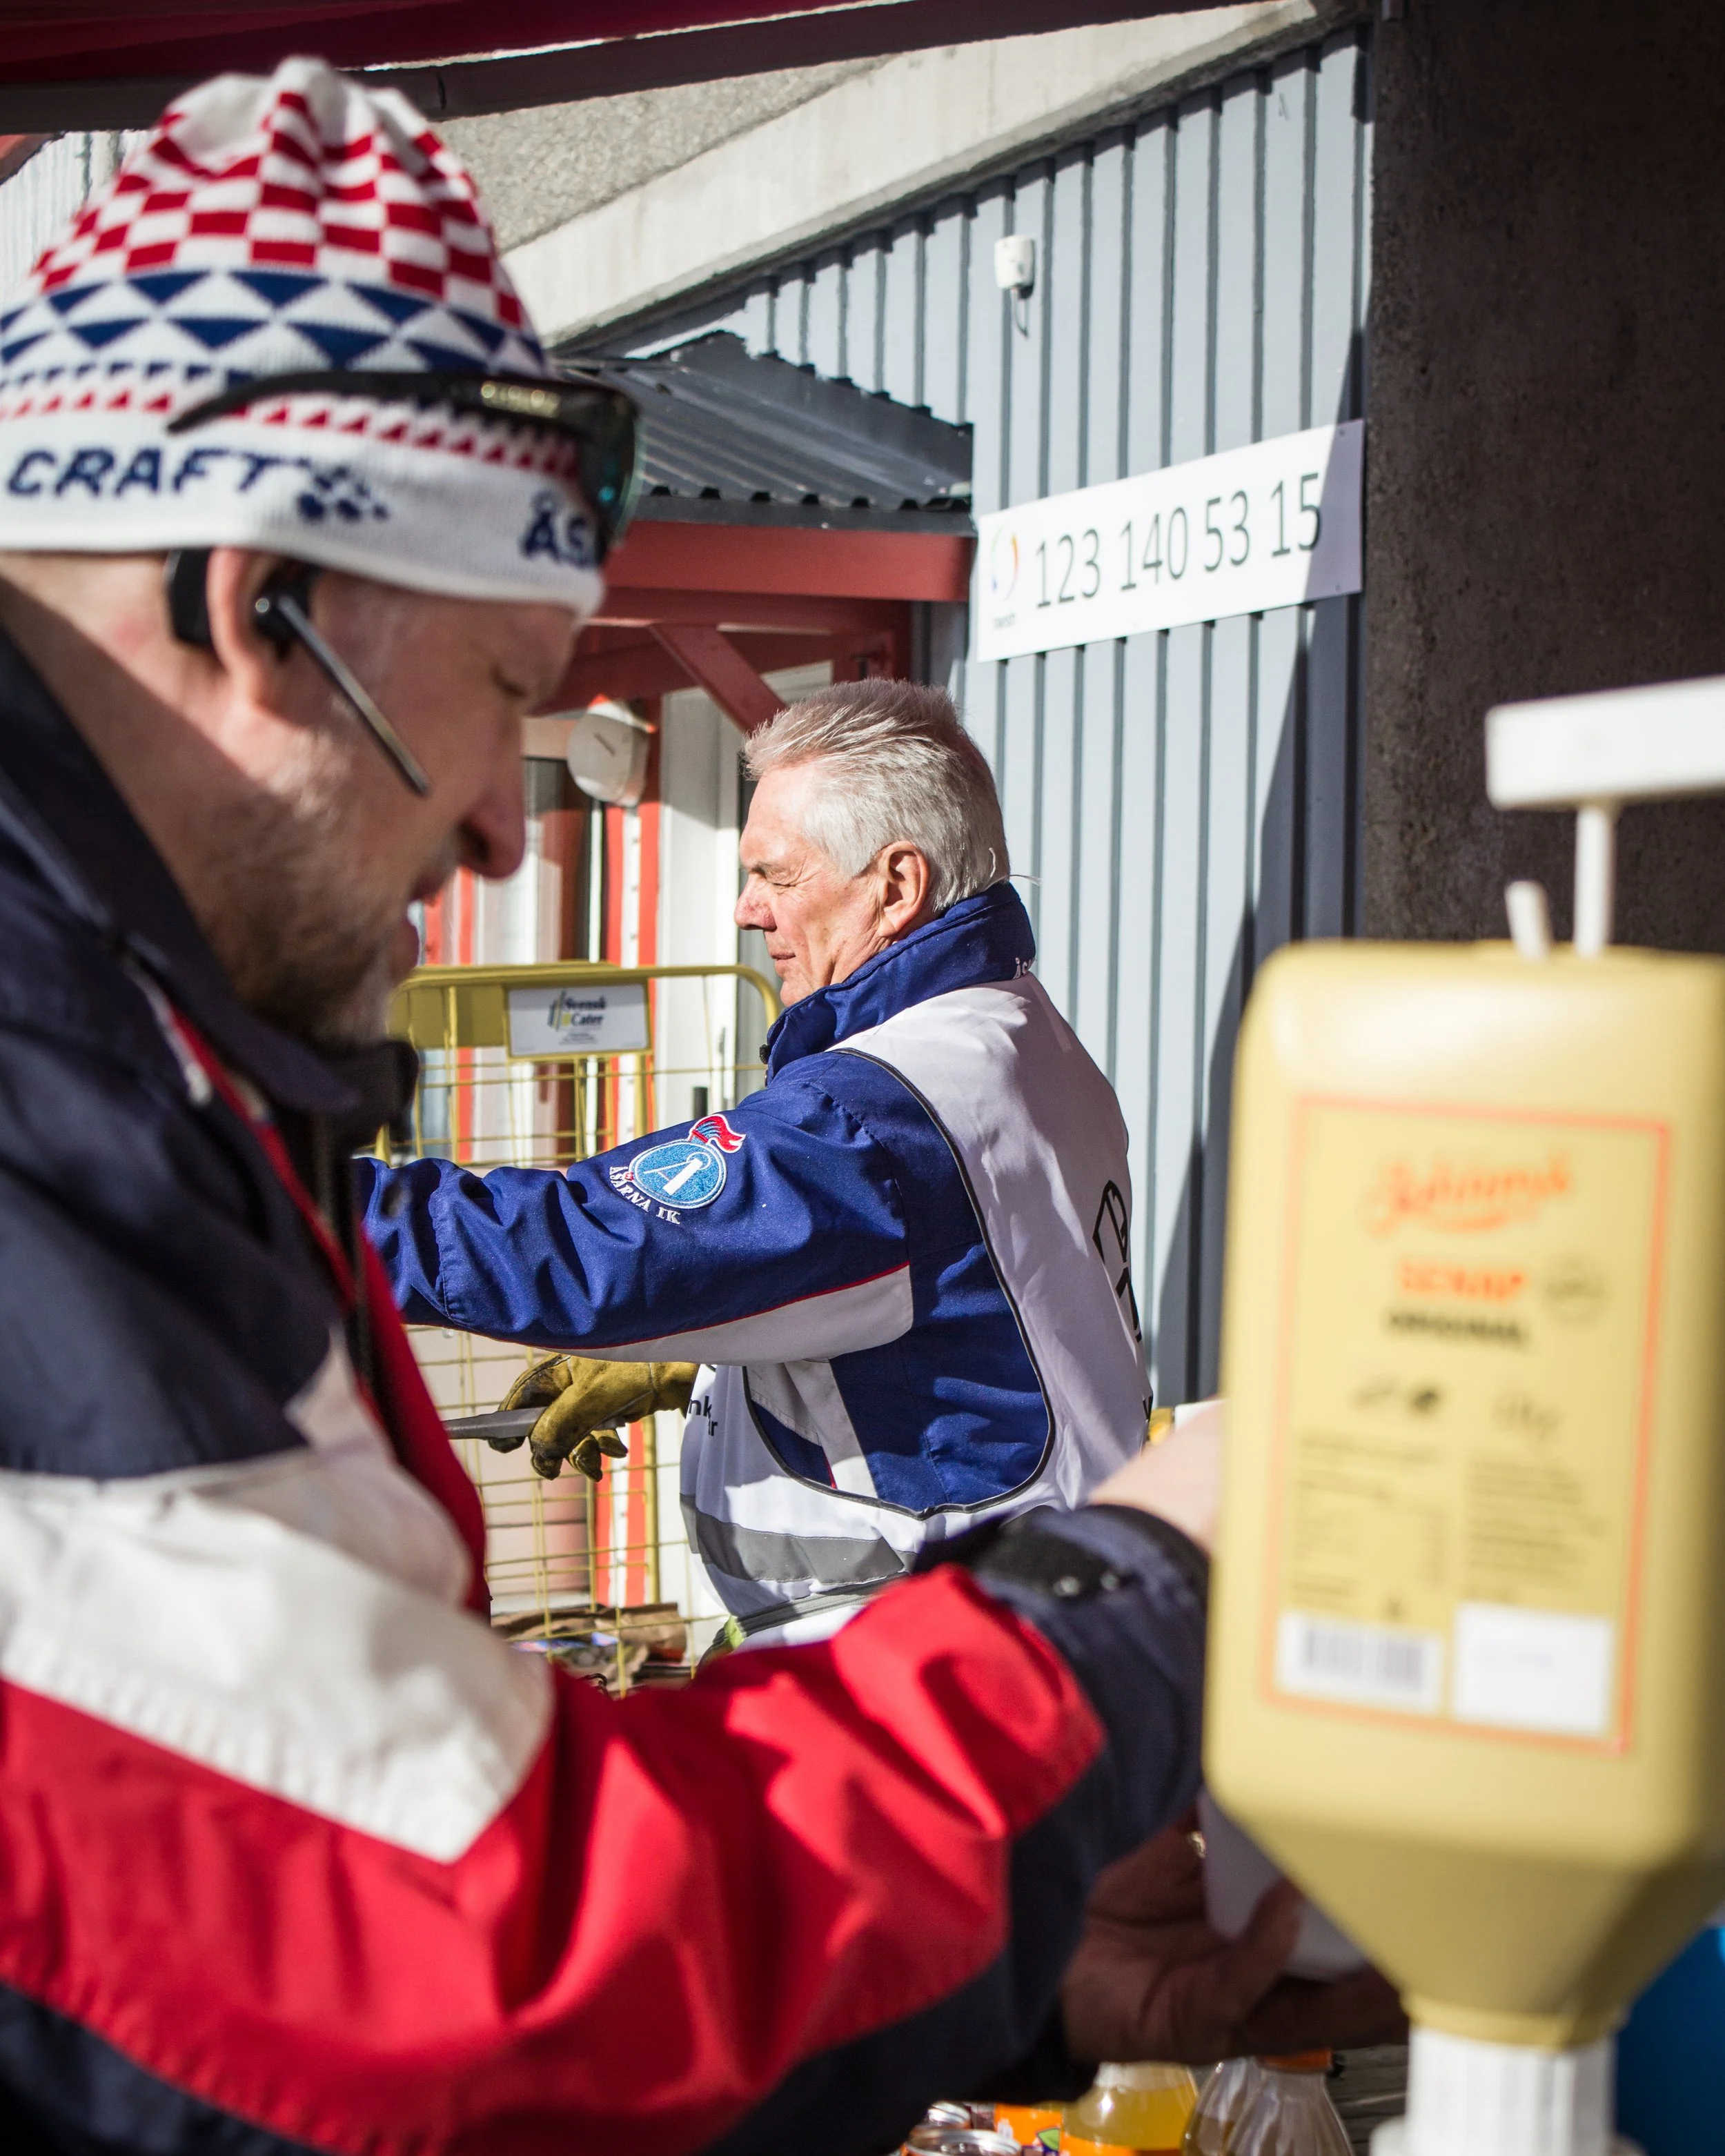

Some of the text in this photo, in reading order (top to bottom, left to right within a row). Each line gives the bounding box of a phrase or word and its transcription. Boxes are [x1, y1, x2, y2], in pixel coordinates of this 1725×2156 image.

[7, 447, 310, 498] CRAFT
[1036, 473, 1321, 609] 123 140 53 15
[656, 1207, 680, 1224] IK
